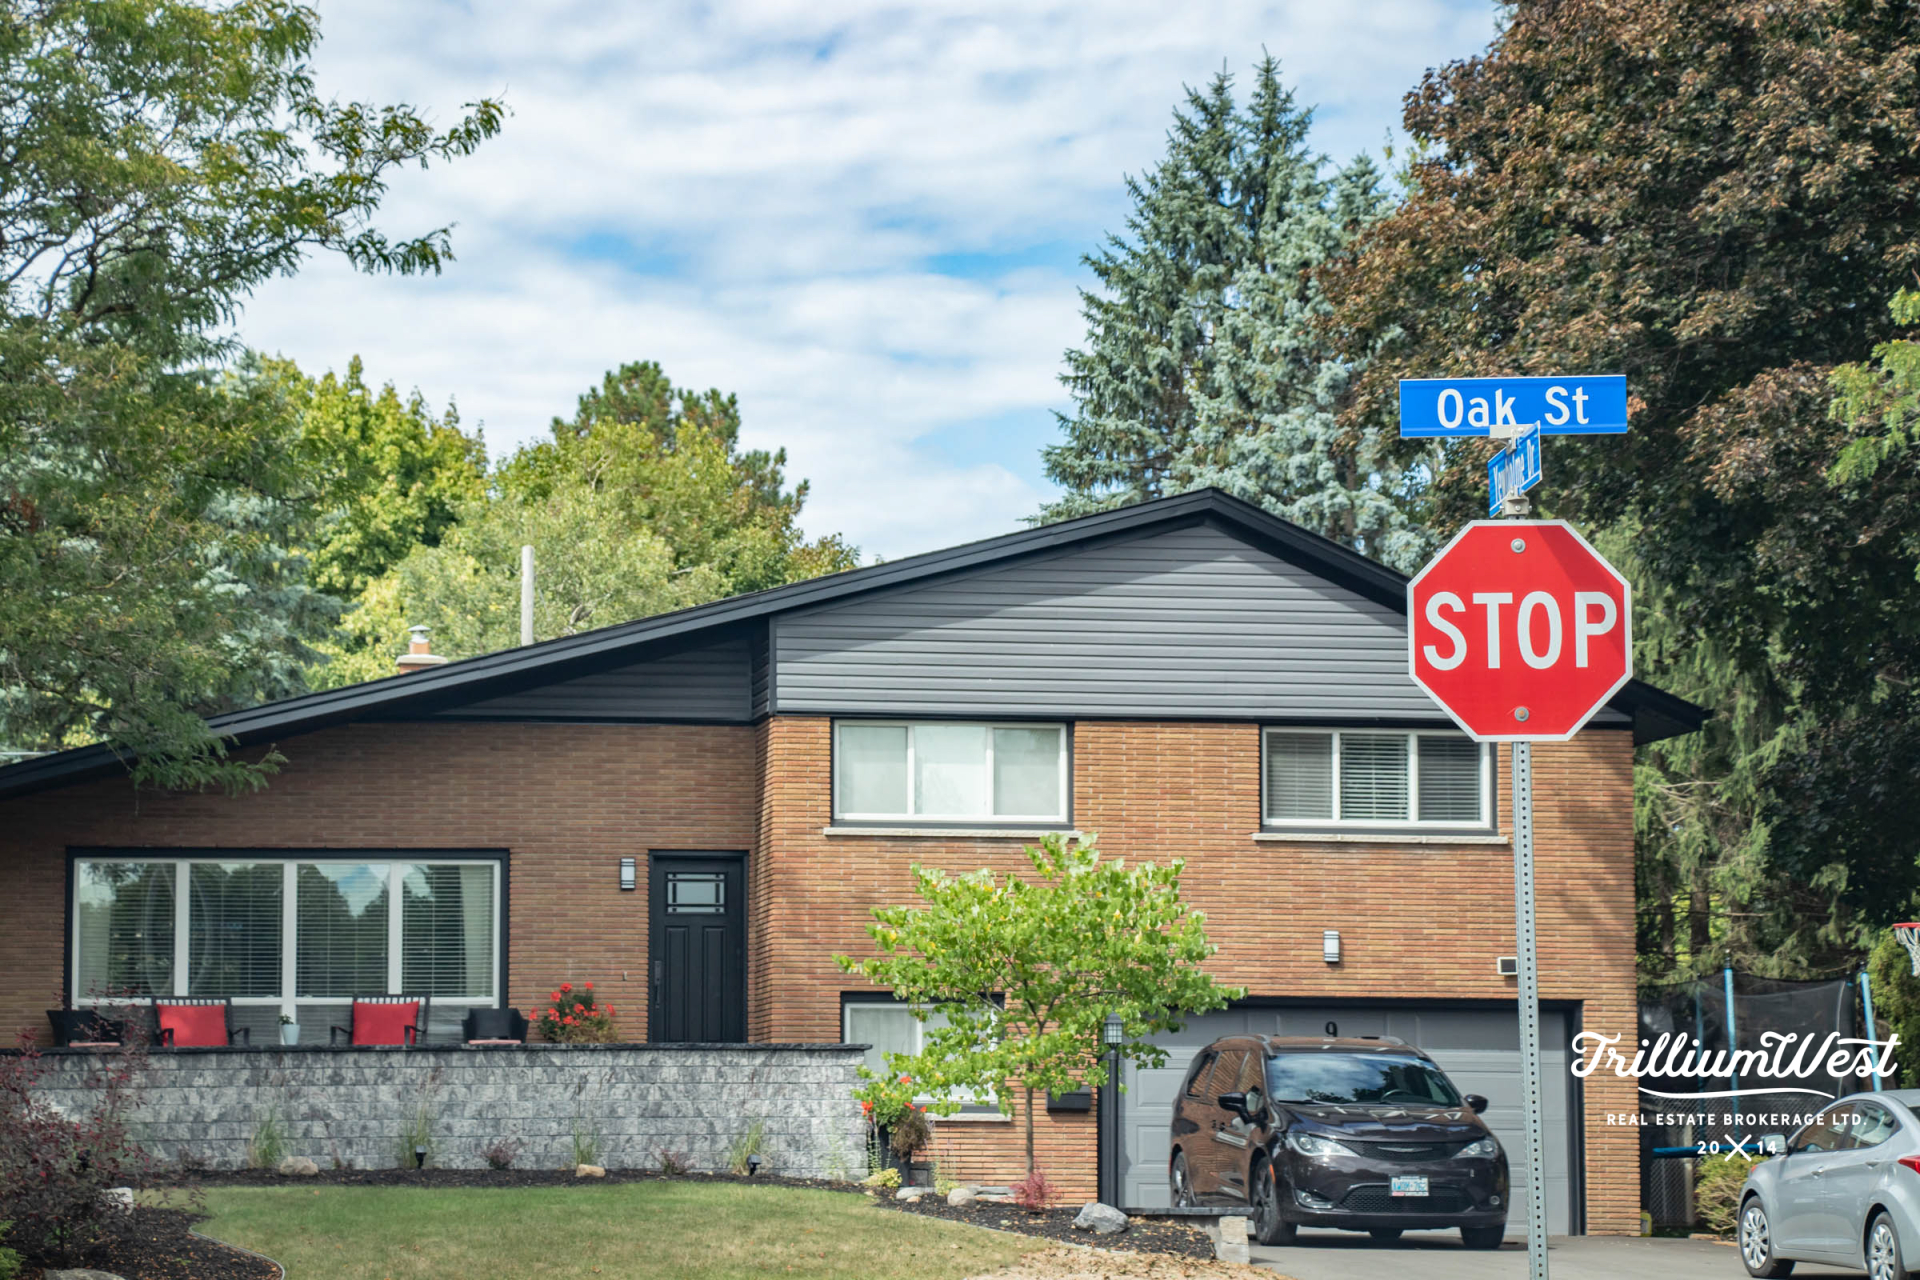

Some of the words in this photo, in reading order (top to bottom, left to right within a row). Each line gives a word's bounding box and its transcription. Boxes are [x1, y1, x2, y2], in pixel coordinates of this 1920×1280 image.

[1437, 388, 1517, 429] Oak
[1544, 386, 1590, 425] St
[1526, 439, 1535, 479] Dr
[1423, 590, 1617, 671] STOP
[1325, 1021, 1338, 1037] 9
